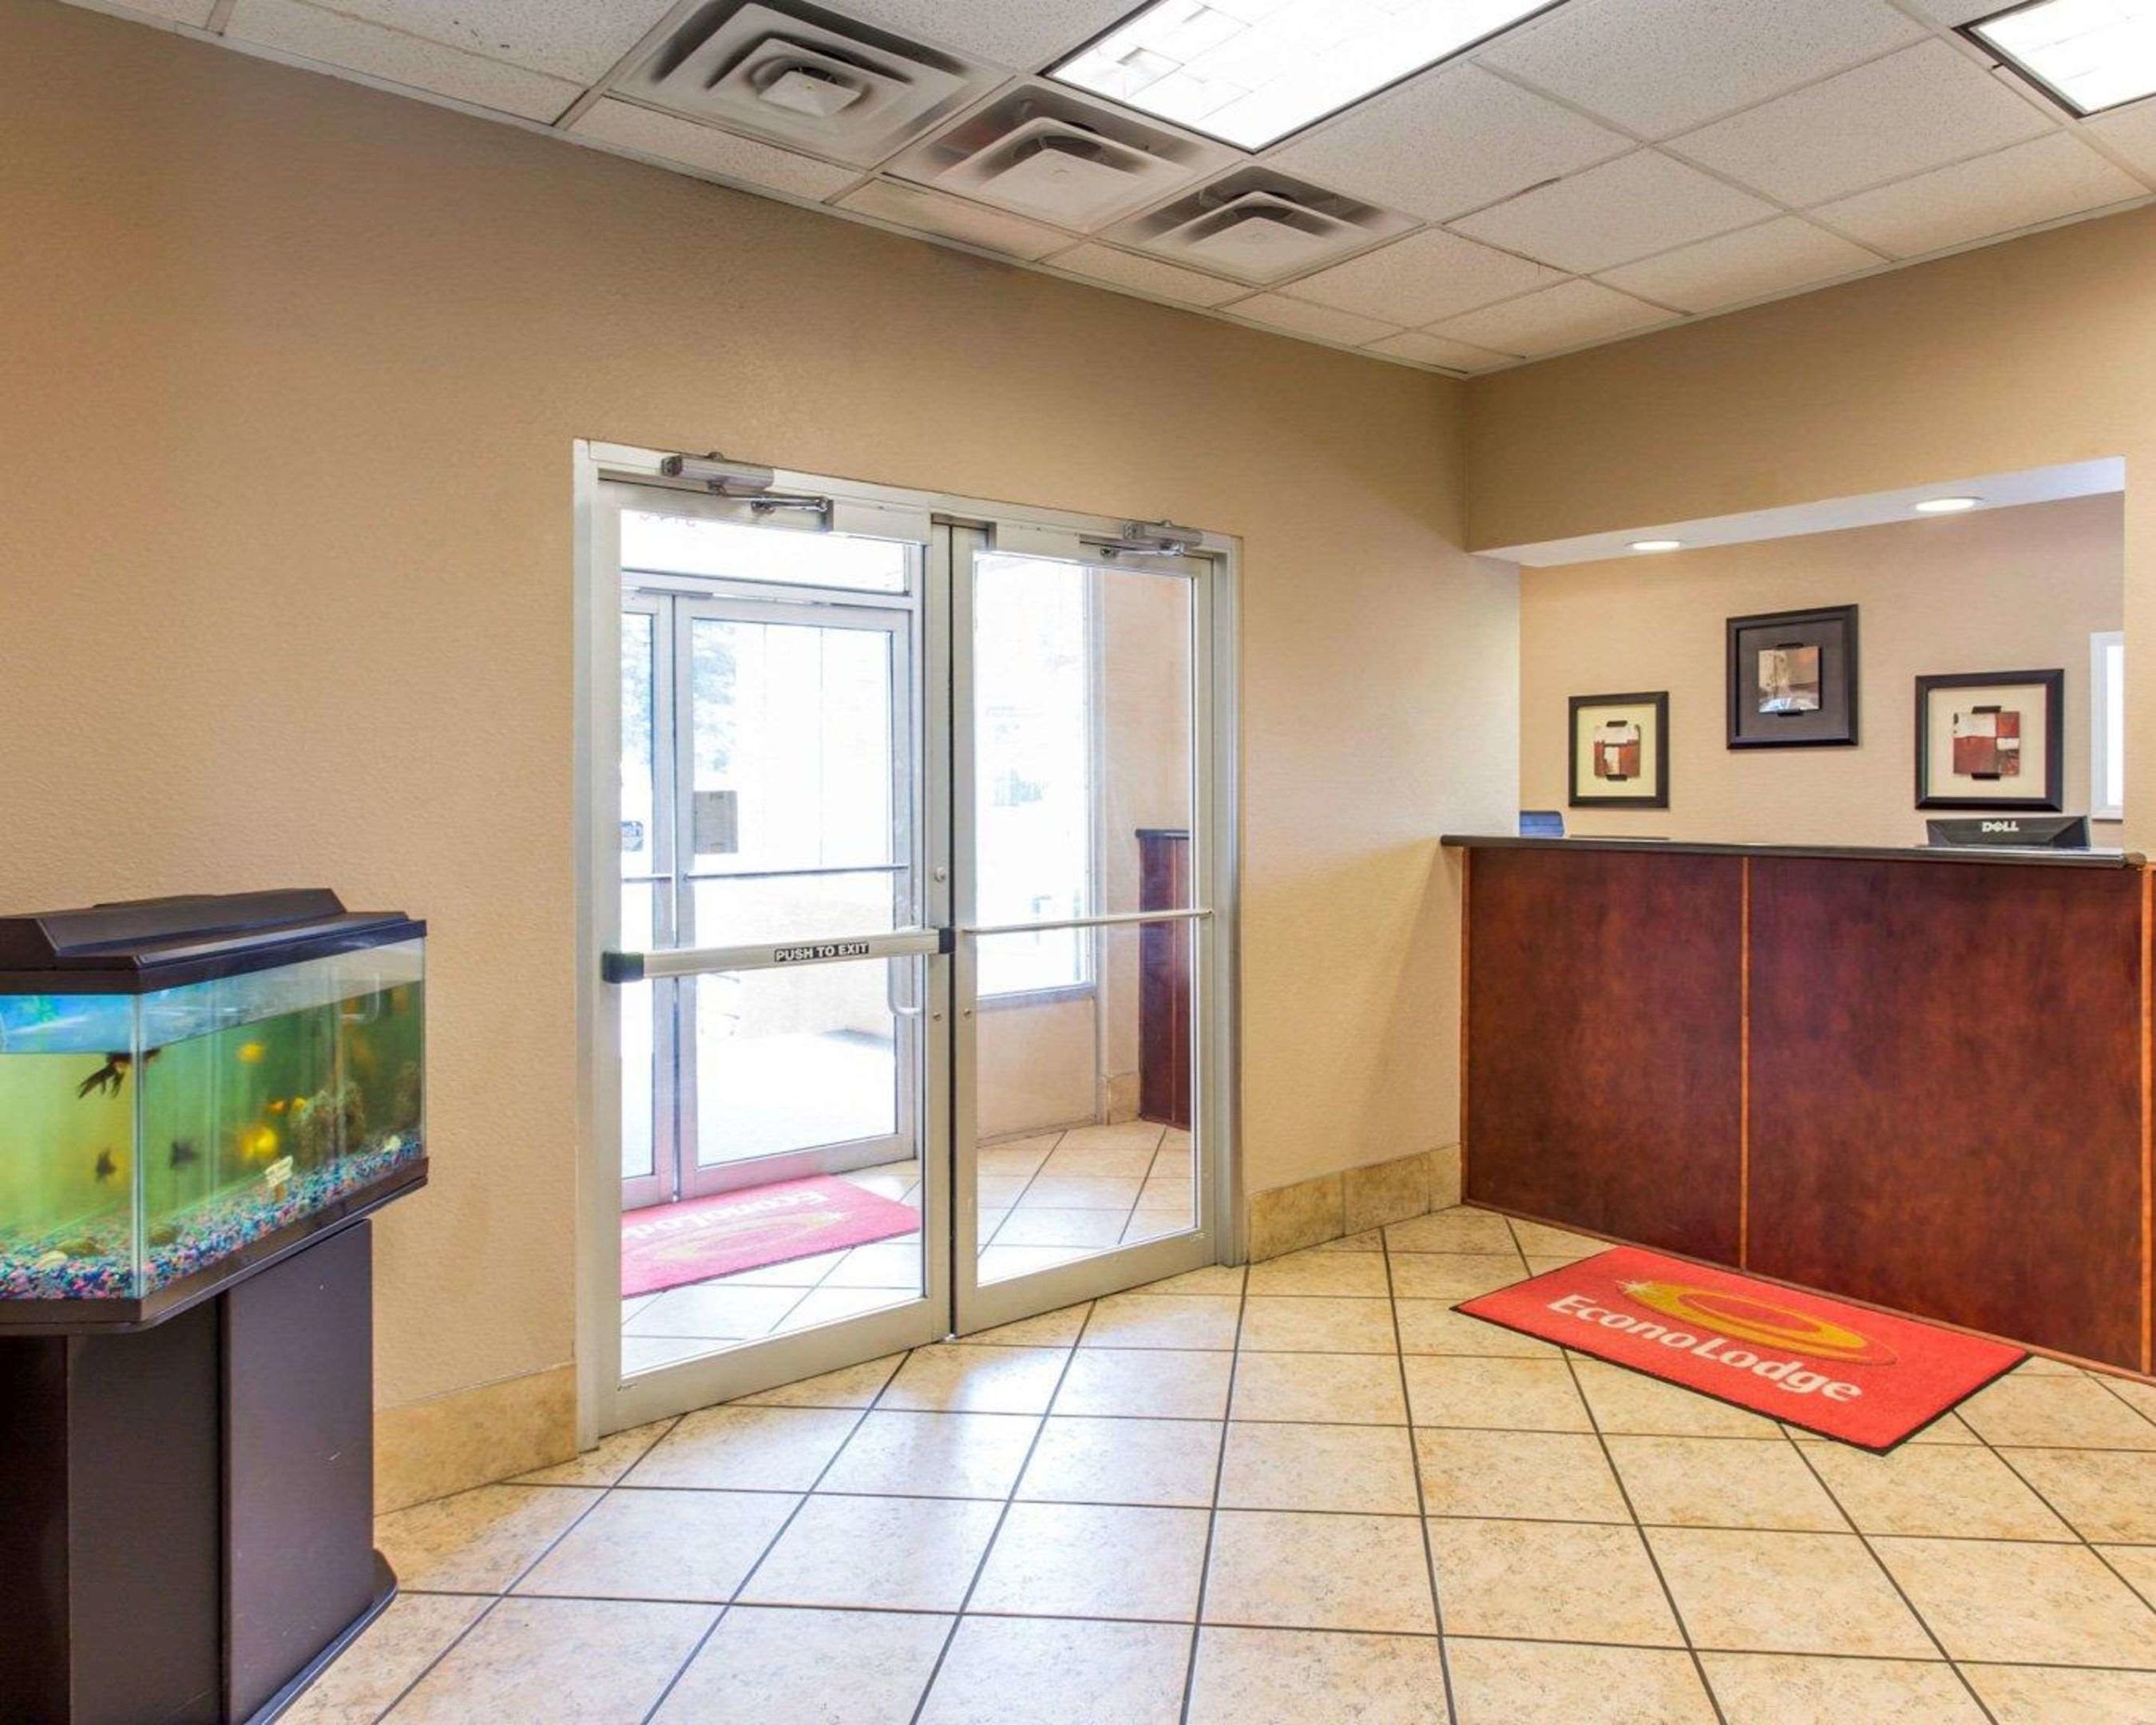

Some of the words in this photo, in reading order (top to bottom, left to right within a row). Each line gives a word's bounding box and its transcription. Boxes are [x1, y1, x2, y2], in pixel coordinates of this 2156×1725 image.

[1982, 821, 2019, 832] DELL
[775, 947, 814, 961] PUSH
[816, 946, 835, 958] TO
[838, 942, 868, 956] EXIT
[1547, 1294, 1862, 1402] EconoLodge
